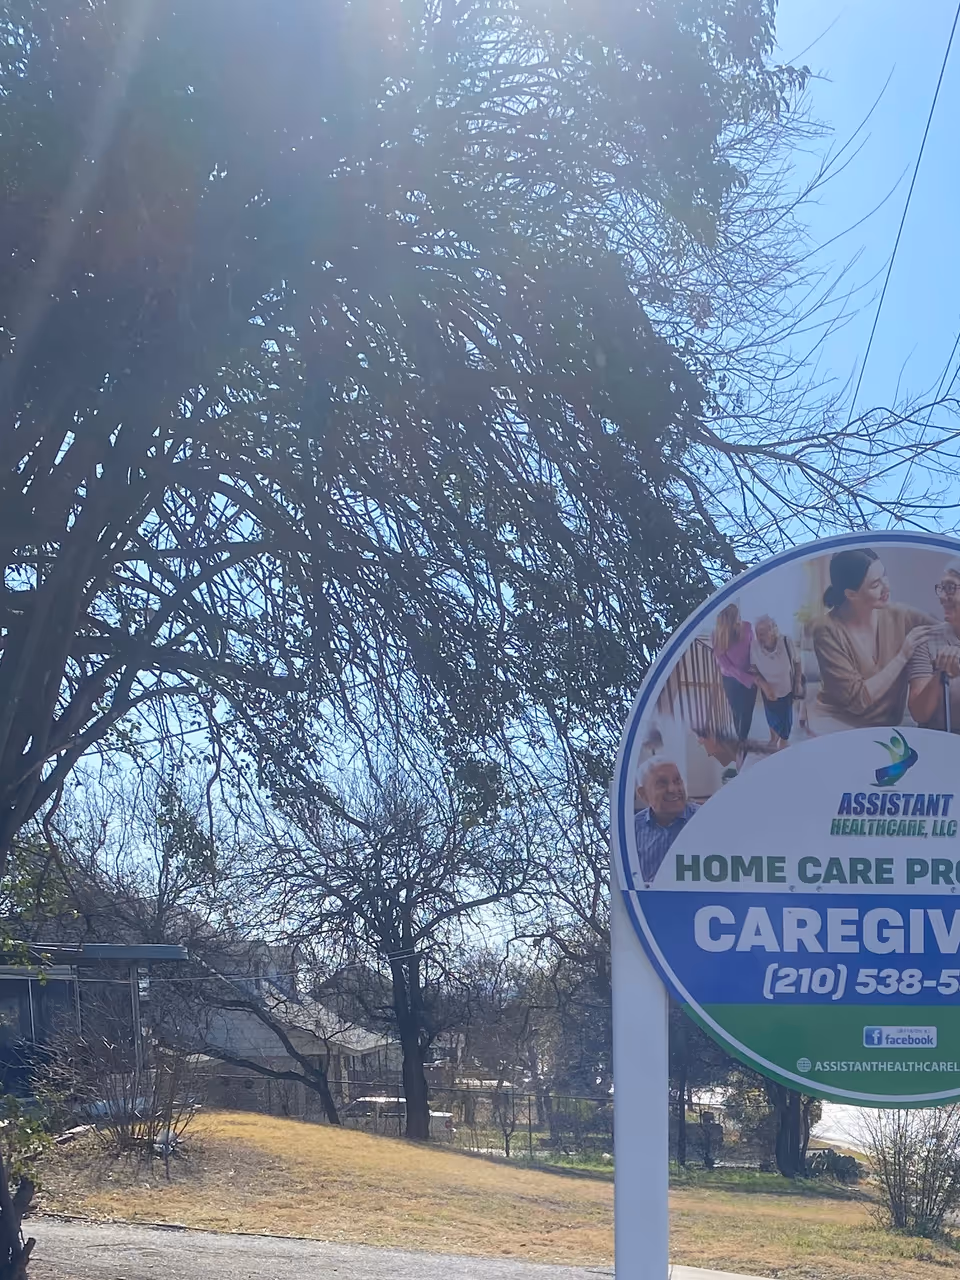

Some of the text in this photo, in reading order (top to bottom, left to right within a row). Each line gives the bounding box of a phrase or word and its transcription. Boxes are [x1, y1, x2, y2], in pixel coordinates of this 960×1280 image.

[837, 792, 954, 817] ASSISTANT
[829, 819, 958, 840] HEALTHCARE, LLC
[675, 854, 787, 884] HOME
[797, 857, 894, 886] CARE
[762, 963, 847, 1000] (210)
[885, 1034, 934, 1045] facebook
